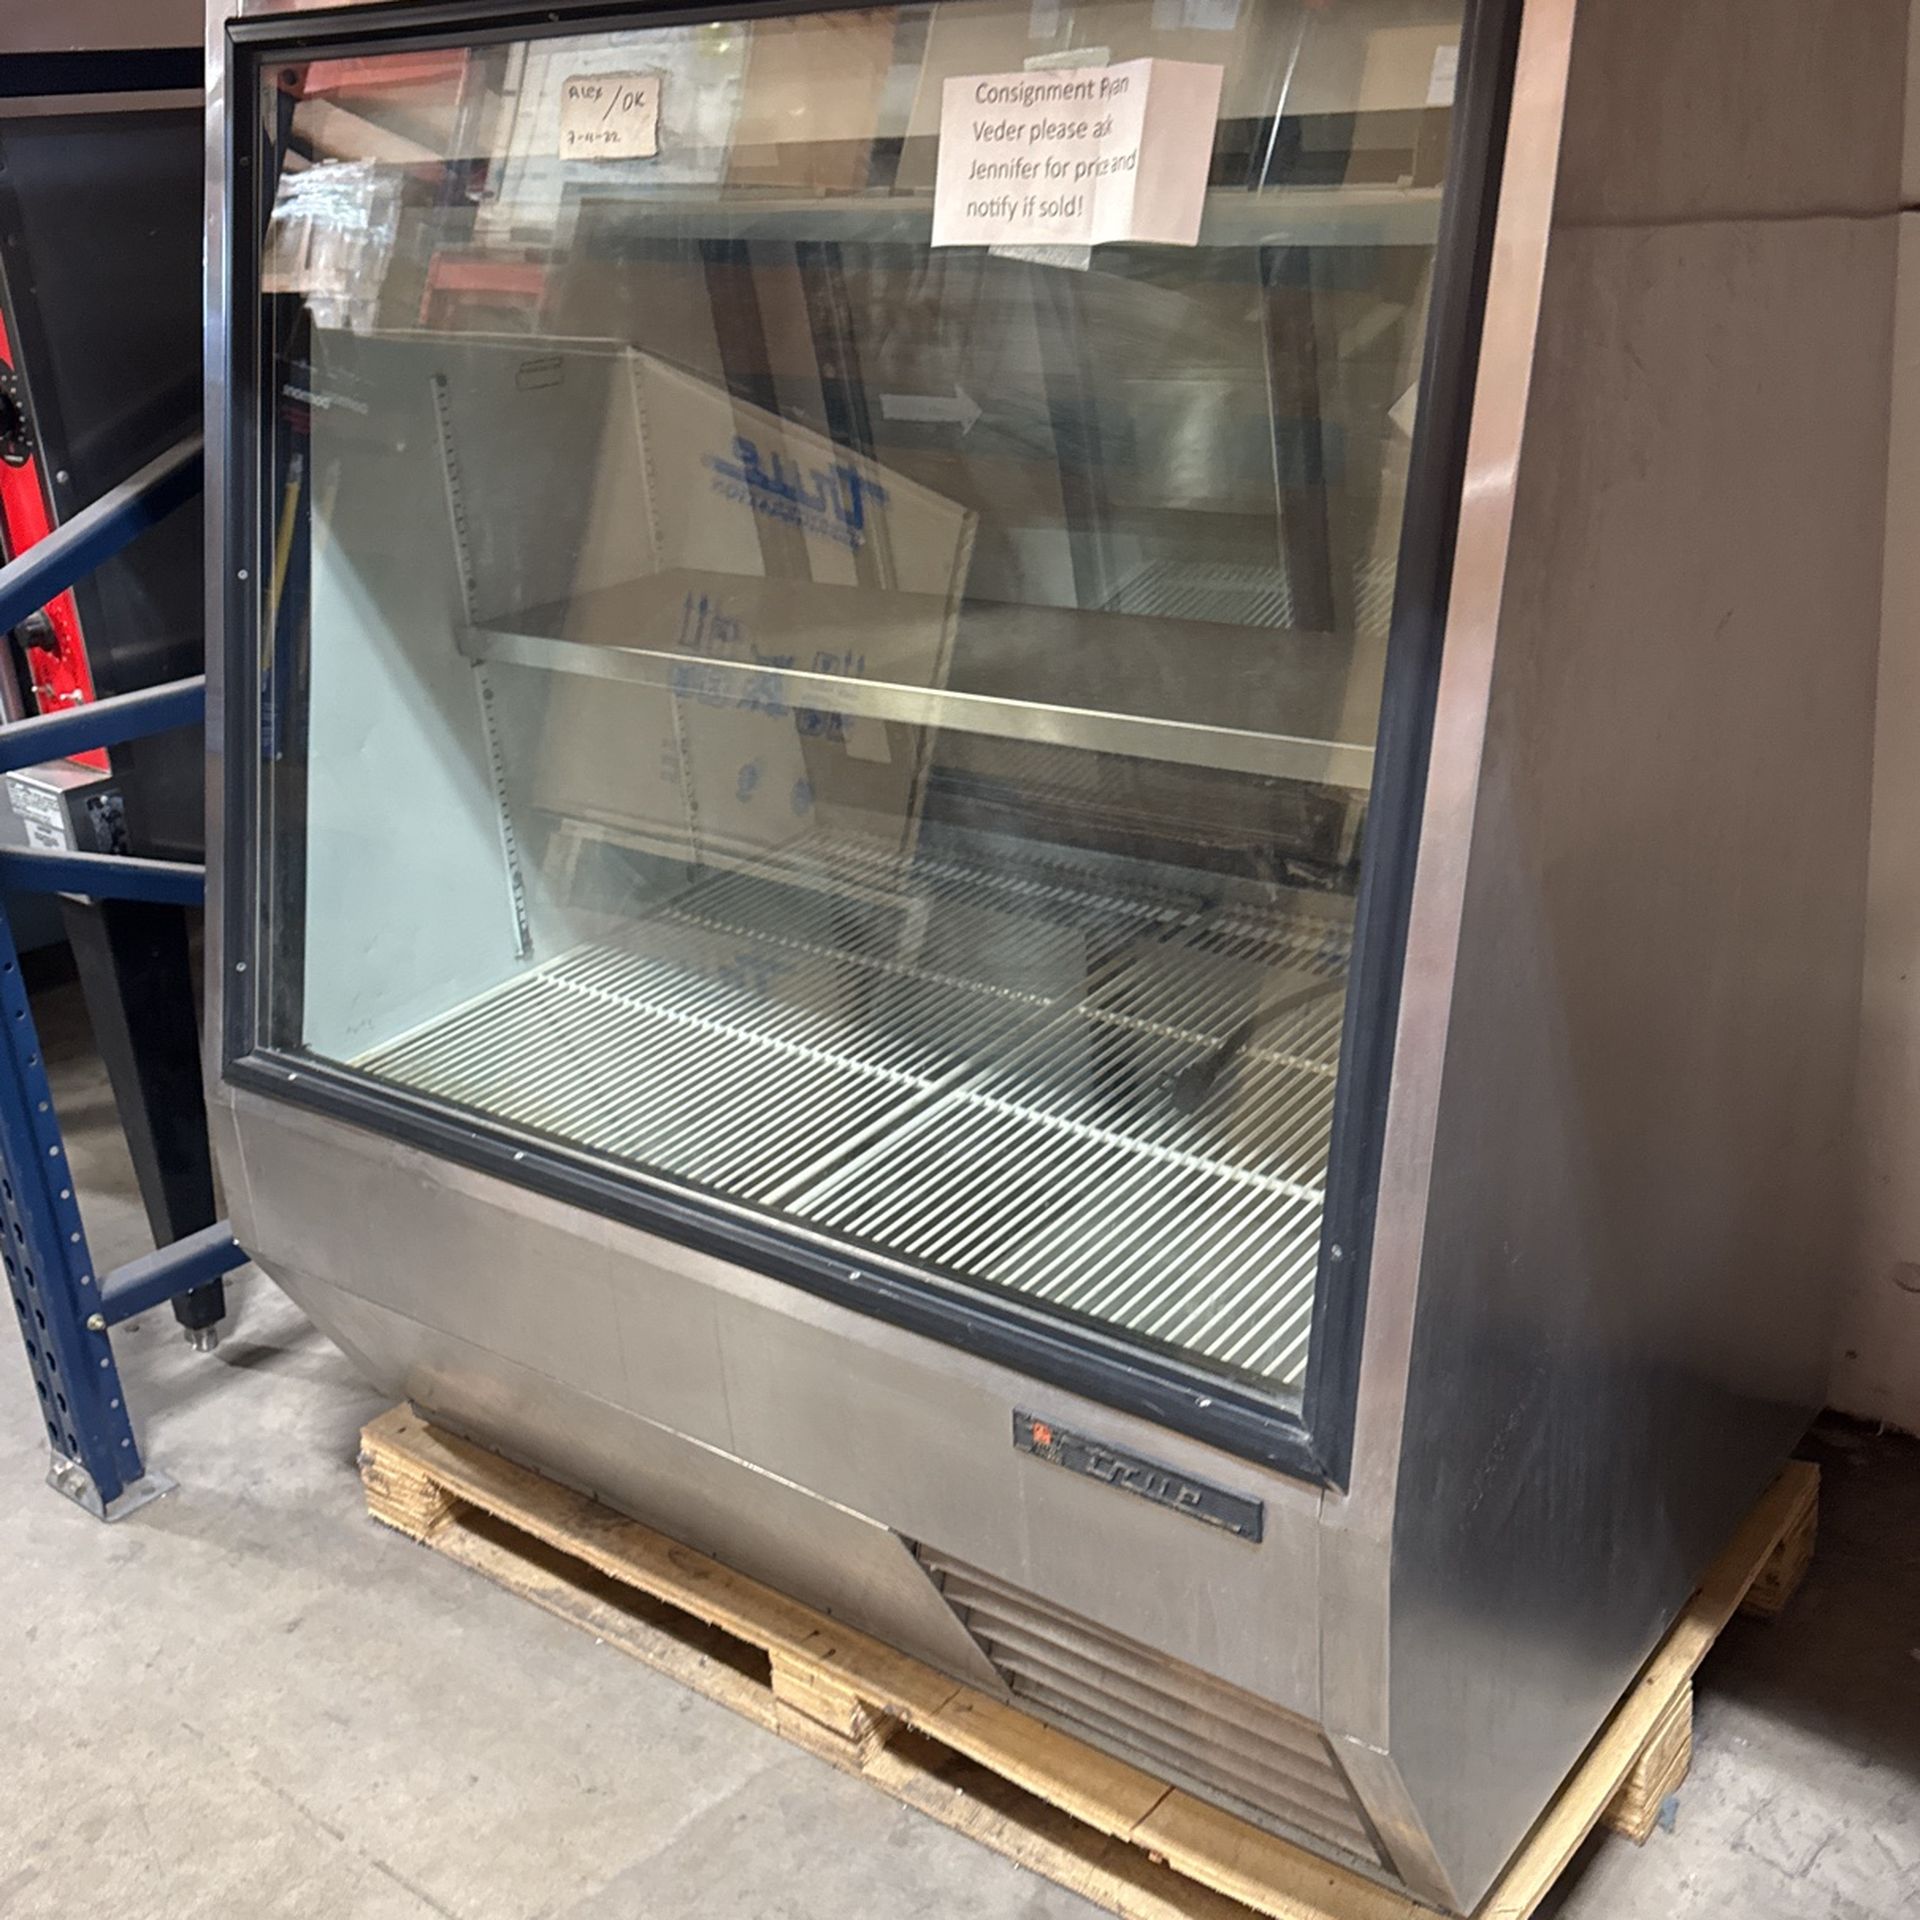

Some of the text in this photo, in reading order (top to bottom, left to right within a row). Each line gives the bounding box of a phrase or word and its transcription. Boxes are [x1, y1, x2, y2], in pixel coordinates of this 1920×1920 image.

[975, 79, 1095, 108] Consignment
[972, 118, 1026, 142] Veder
[1029, 117, 1088, 145] please
[968, 156, 1040, 180] Jennifer
[1044, 155, 1071, 177] for
[966, 194, 1084, 222] notify if sold!
